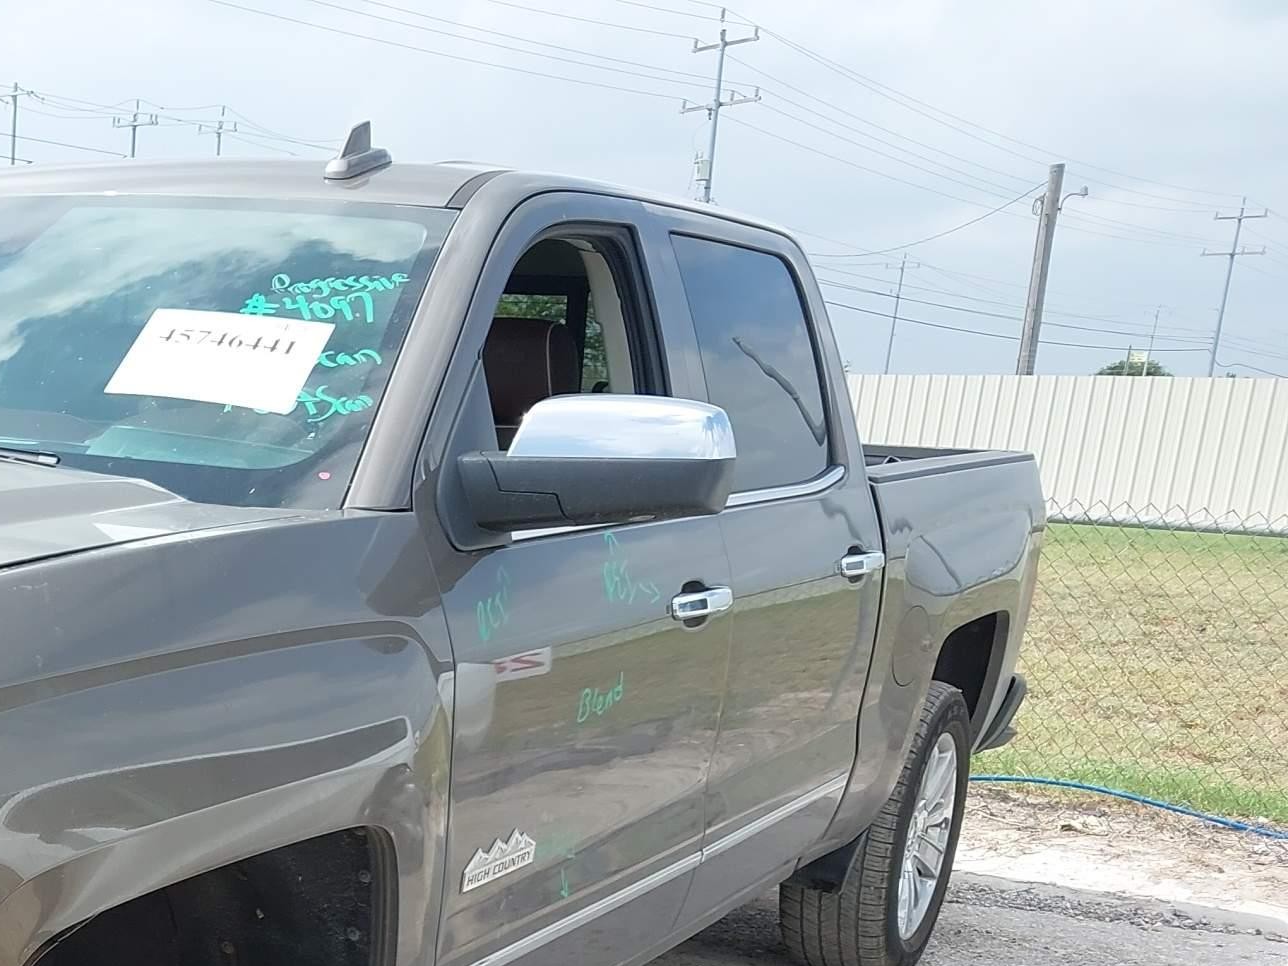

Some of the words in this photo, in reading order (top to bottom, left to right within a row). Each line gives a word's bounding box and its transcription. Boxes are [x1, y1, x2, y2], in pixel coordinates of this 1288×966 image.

[159, 328, 297, 355] 45746441
[576, 671, 624, 723] Blend
[466, 868, 490, 886] HIGH
[492, 850, 531, 876] COUNTRY
